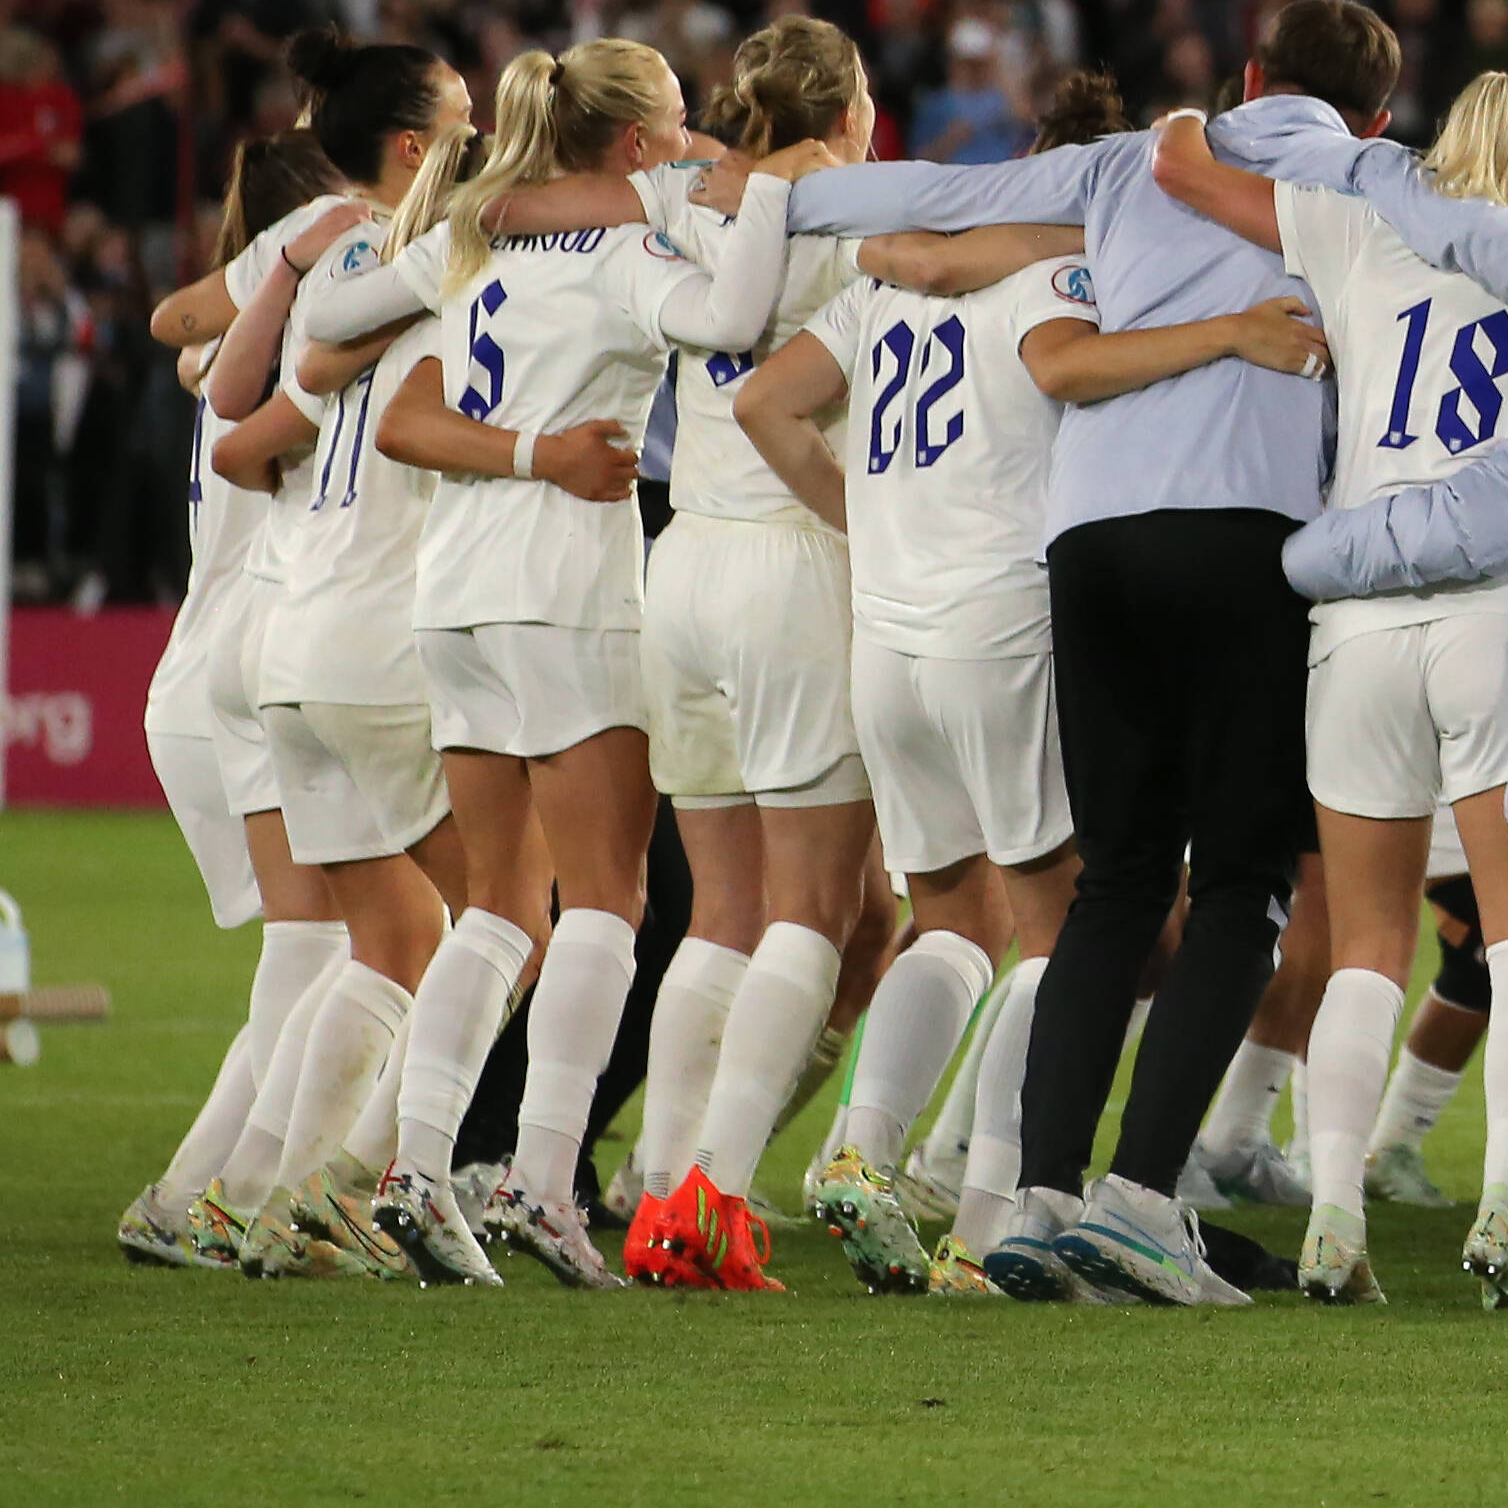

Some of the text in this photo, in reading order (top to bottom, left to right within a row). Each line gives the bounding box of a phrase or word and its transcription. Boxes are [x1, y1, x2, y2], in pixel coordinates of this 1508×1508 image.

[457, 278, 508, 423] 5
[867, 313, 966, 475] 22
[9, 691, 93, 765] rg
